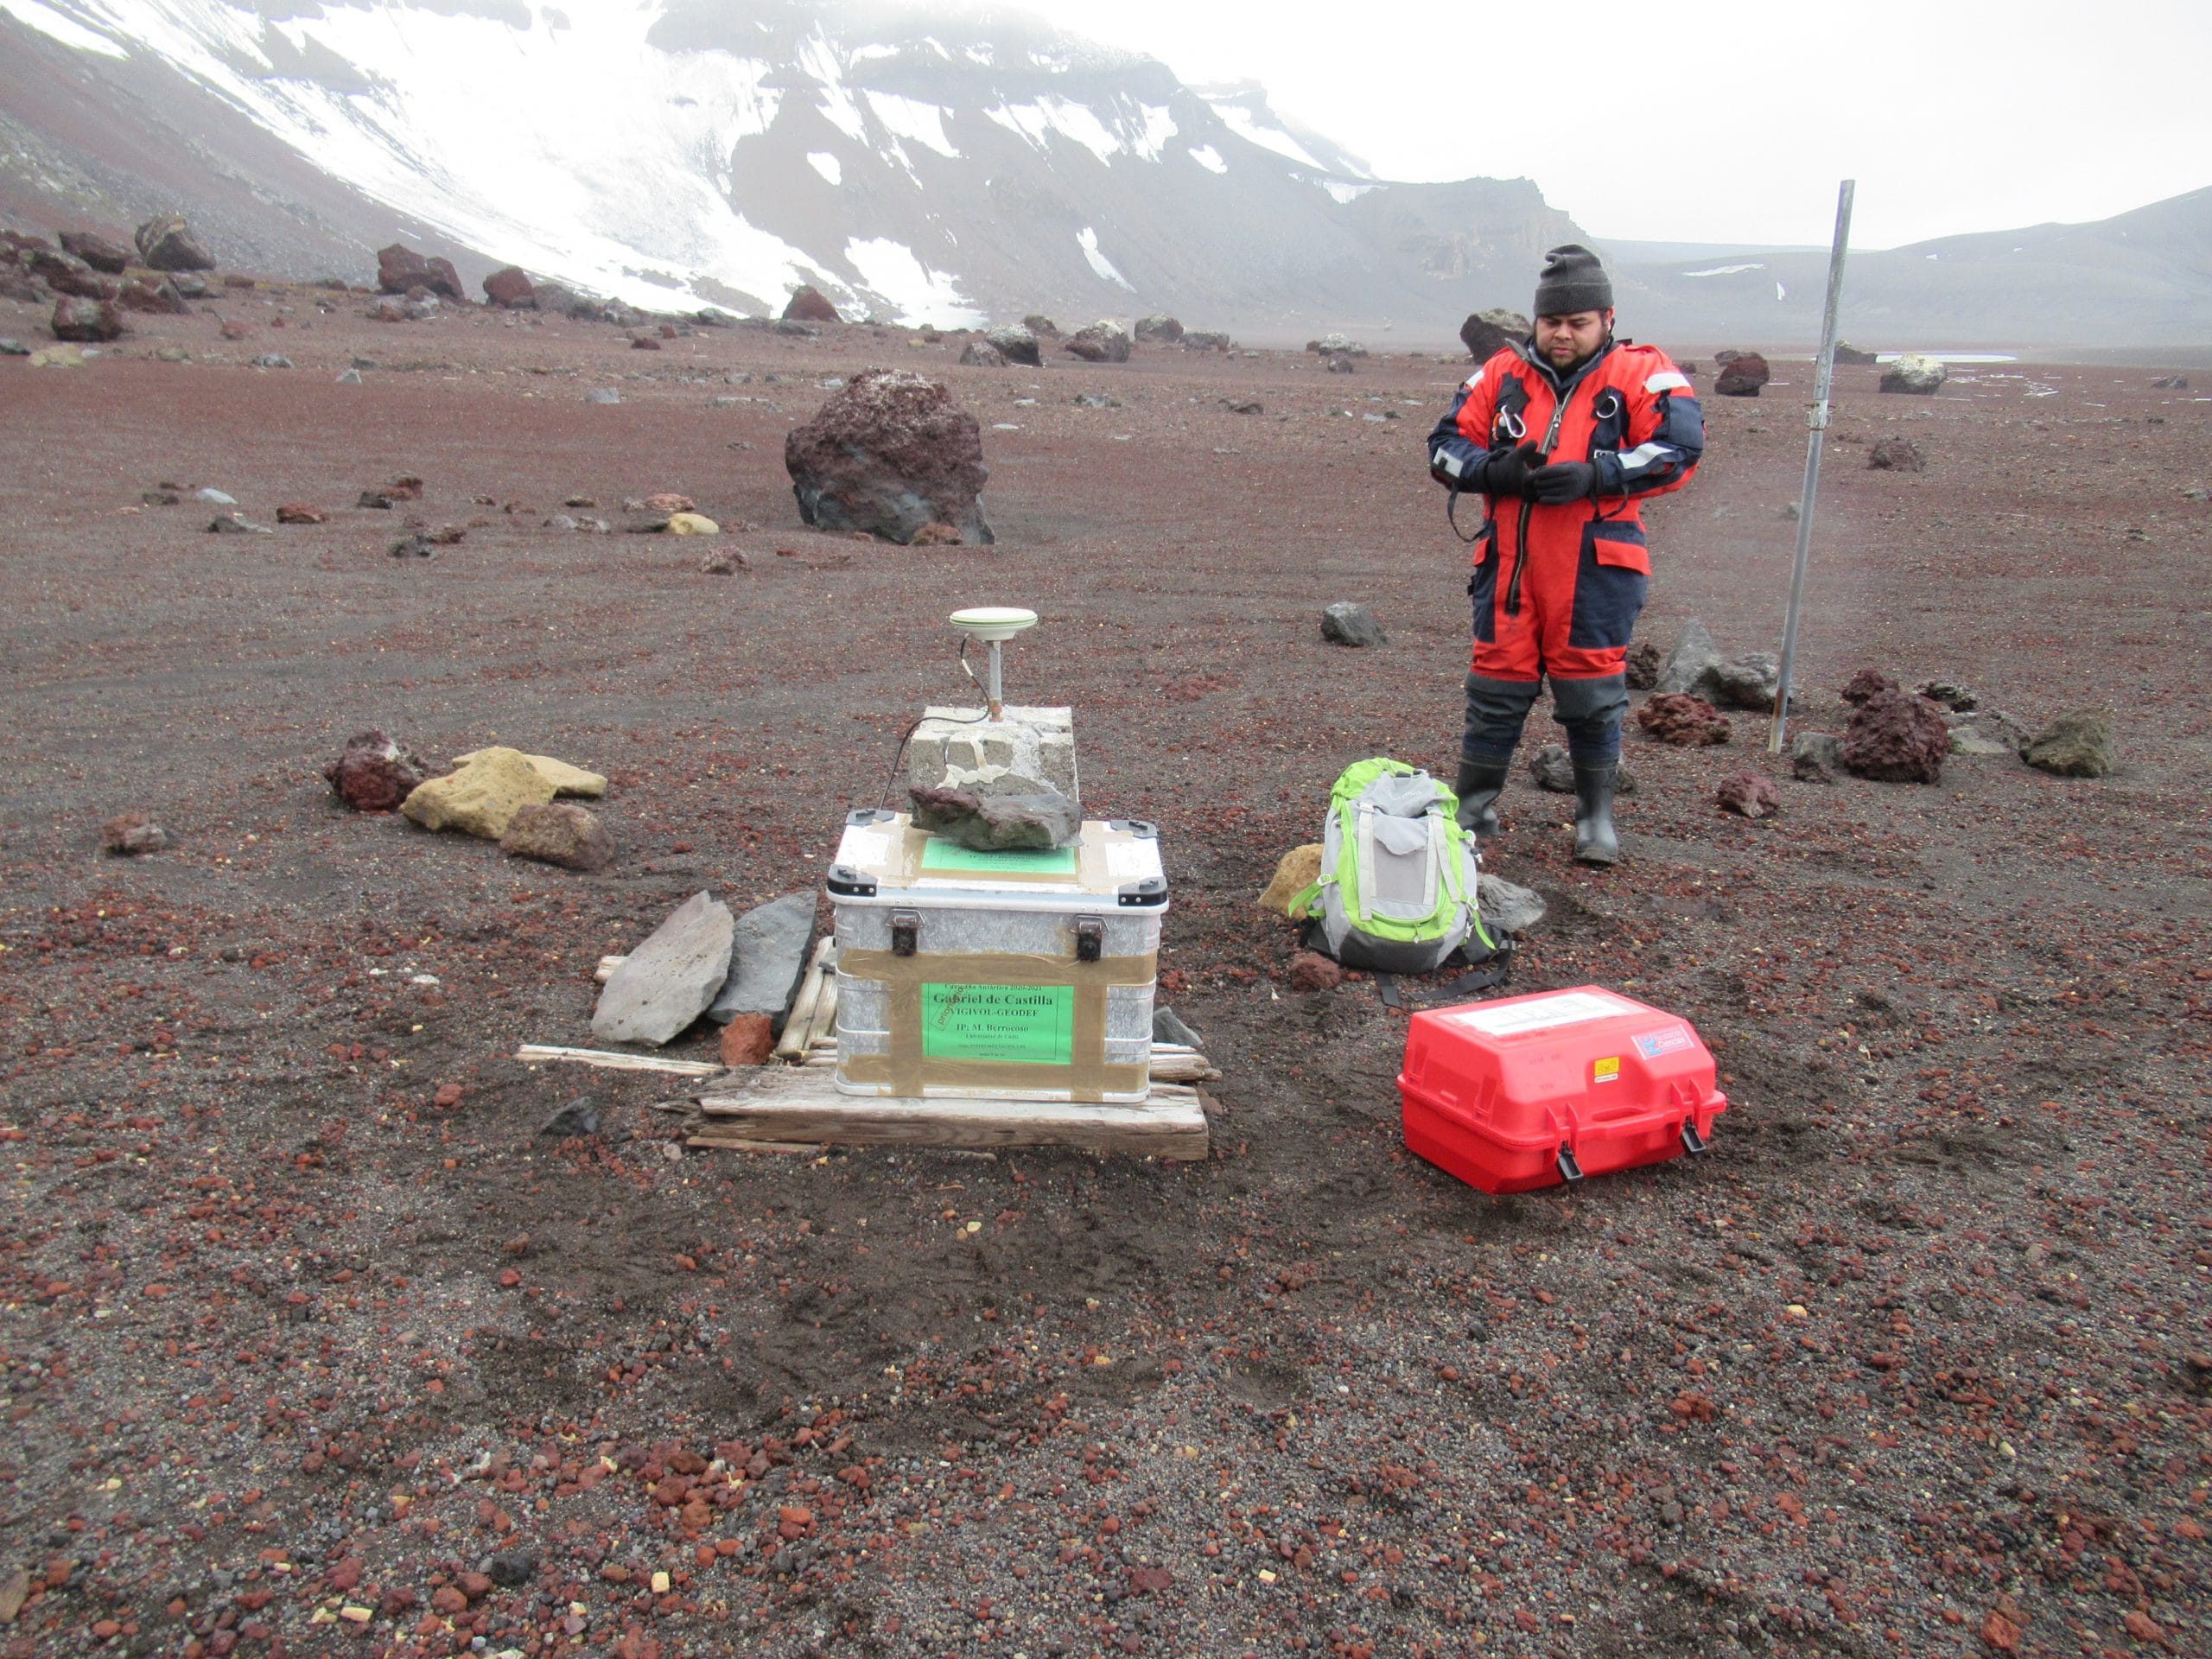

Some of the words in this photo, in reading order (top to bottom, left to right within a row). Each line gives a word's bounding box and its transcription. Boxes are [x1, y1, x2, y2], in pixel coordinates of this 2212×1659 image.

[933, 994, 982, 1004] Gabriel
[986, 995, 1001, 1004] de
[1005, 995, 1052, 1005] Castilla
